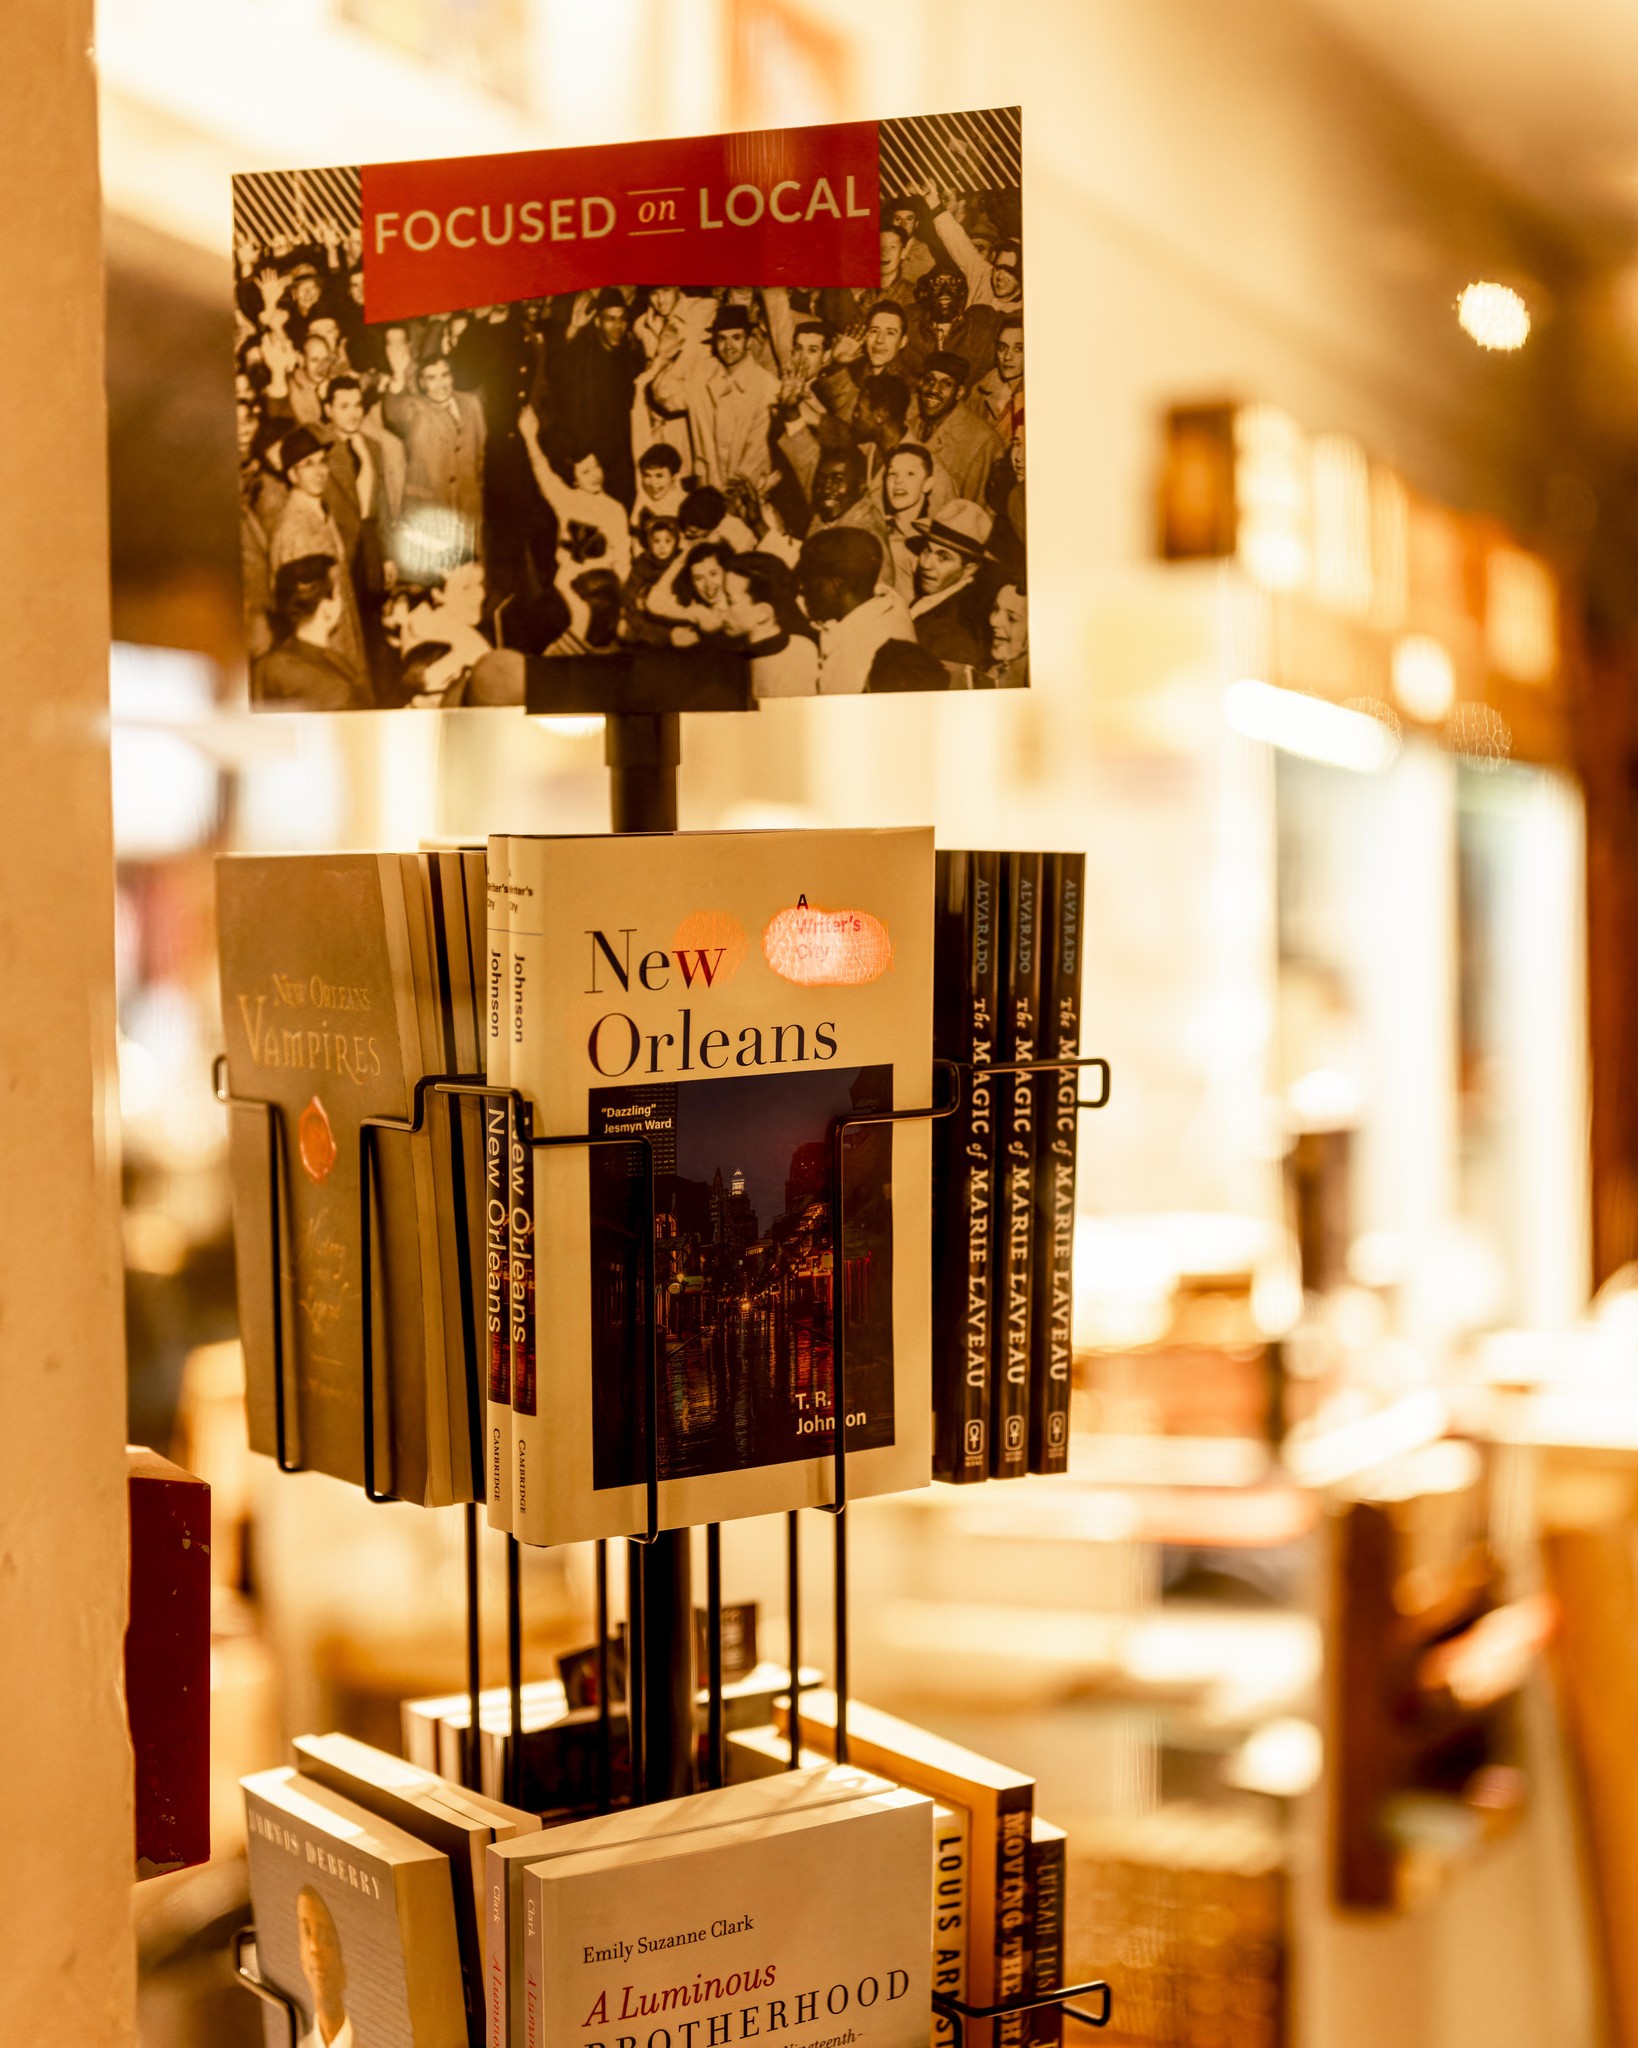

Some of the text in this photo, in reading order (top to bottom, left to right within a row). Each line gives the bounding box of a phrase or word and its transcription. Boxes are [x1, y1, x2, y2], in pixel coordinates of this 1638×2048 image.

[375, 175, 871, 254] FOCUSED on LOCAL
[796, 915, 861, 934] Writer's
[797, 893, 809, 910] A
[584, 927, 727, 994] New
[796, 942, 829, 962] City
[491, 949, 502, 1038] Johnson
[514, 954, 526, 1043] Johnson
[587, 1008, 838, 1077] Orleans
[604, 1117, 672, 1134] Jesmyn Ward
[966, 878, 991, 1388] ALVARADO The MAGIC of MARIE LAVEAU
[1007, 878, 1034, 1385] ALVARADO The MAGIC of MARIE LAVEAU
[1049, 878, 1077, 1382] ALVARADO The MAGIC of MARIE LAVEAU
[488, 1108, 507, 1333] New Orleans
[512, 1113, 532, 1343] ew Orleans
[795, 1390, 832, 1410] T. R.
[796, 1411, 867, 1435] Johnon
[493, 1428, 501, 1502] CAMBRIDGE
[518, 1439, 526, 1514] CAMBRIDGE
[493, 1885, 501, 1923] Clark
[937, 1836, 962, 1931] LOUIS
[1002, 1811, 1026, 1929] MOVING
[527, 1899, 536, 1937] Clark
[582, 1914, 755, 1964] Emily Suzanne Clark
[581, 1964, 777, 2028] A Luminous
[1001, 1936, 1024, 1996] THE
[584, 1969, 910, 2048] OTHERHOOD
